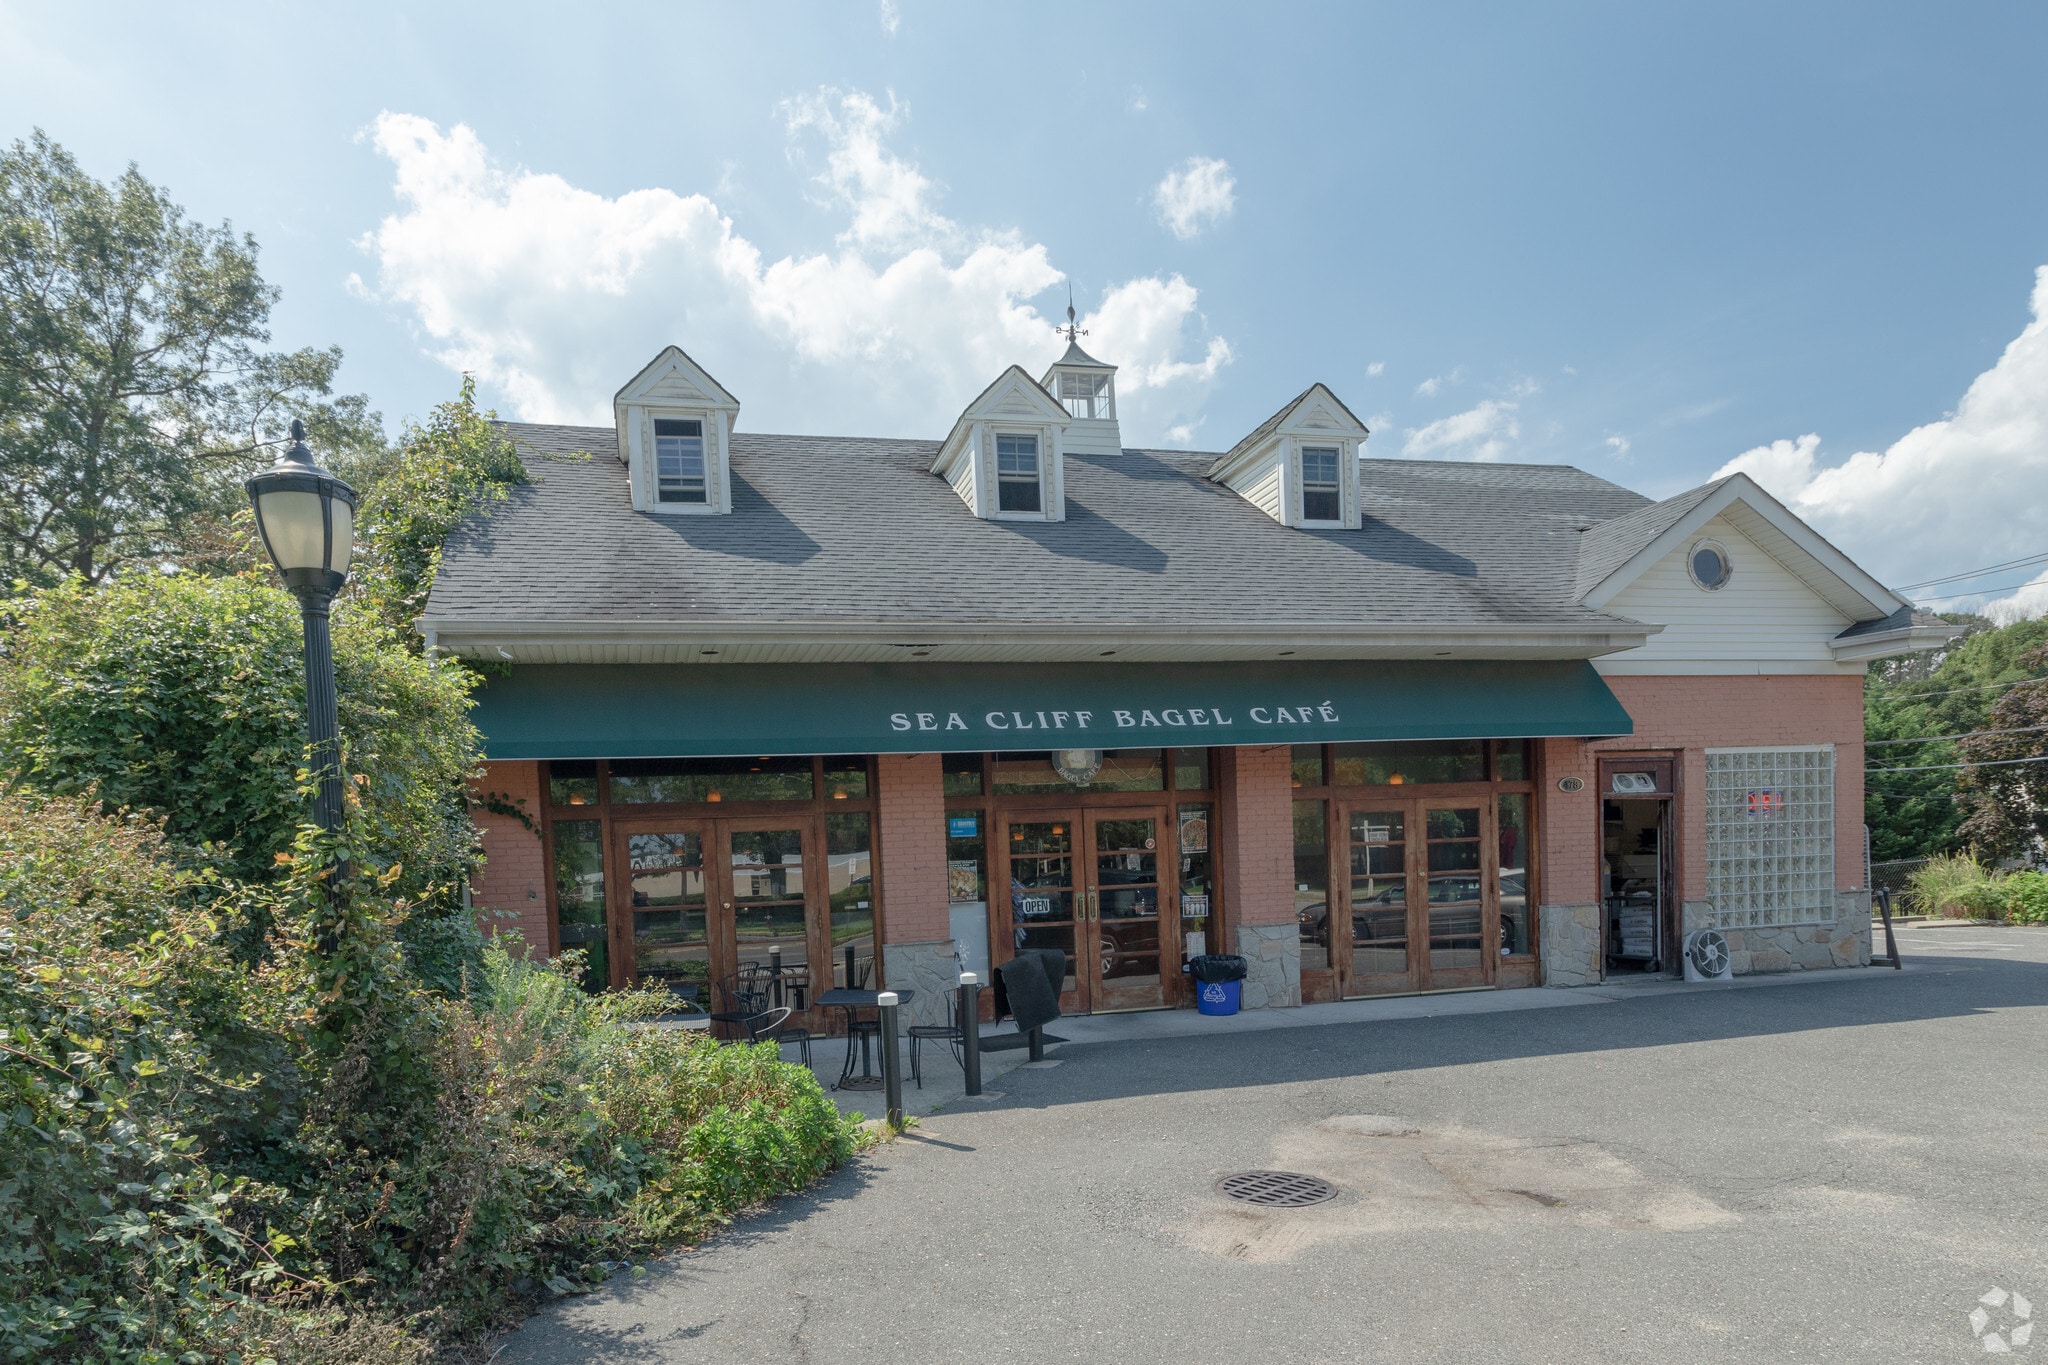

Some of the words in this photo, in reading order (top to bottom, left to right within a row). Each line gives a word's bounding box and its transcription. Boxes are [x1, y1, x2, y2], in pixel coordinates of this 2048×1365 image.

[890, 712, 969, 731] SEA
[985, 710, 1094, 730] CLIFF
[1112, 707, 1233, 728] BAGEL
[1249, 700, 1340, 724] CAFÉ
[1058, 767, 1080, 782] BAGEL
[1025, 899, 1049, 913] OPEN
